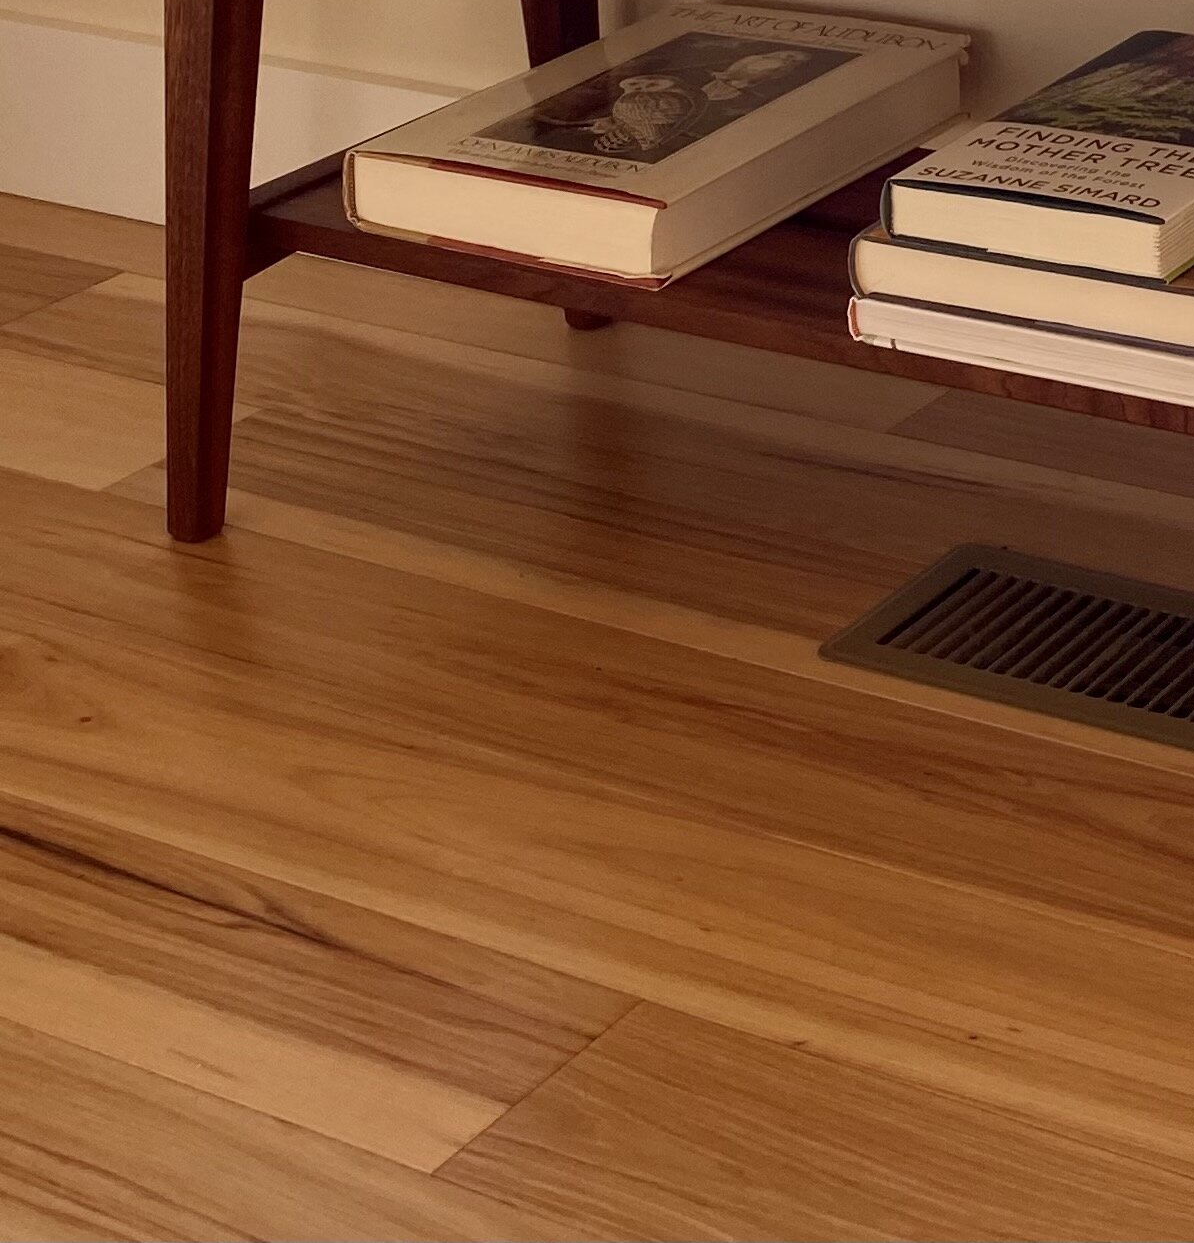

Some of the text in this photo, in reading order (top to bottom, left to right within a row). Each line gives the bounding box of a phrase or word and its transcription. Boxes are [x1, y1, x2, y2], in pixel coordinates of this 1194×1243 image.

[669, 7, 724, 21] THE
[726, 14, 777, 29] ART
[772, 19, 815, 32] OF
[809, 24, 948, 51] AUDUBON
[967, 137, 1107, 165] MOTHER
[996, 126, 1134, 153] FINDING
[971, 159, 1146, 190] Wisdom of the Forest
[1004, 155, 1131, 178] Discovering the
[917, 166, 1161, 209] SUZANNE SIMARD
